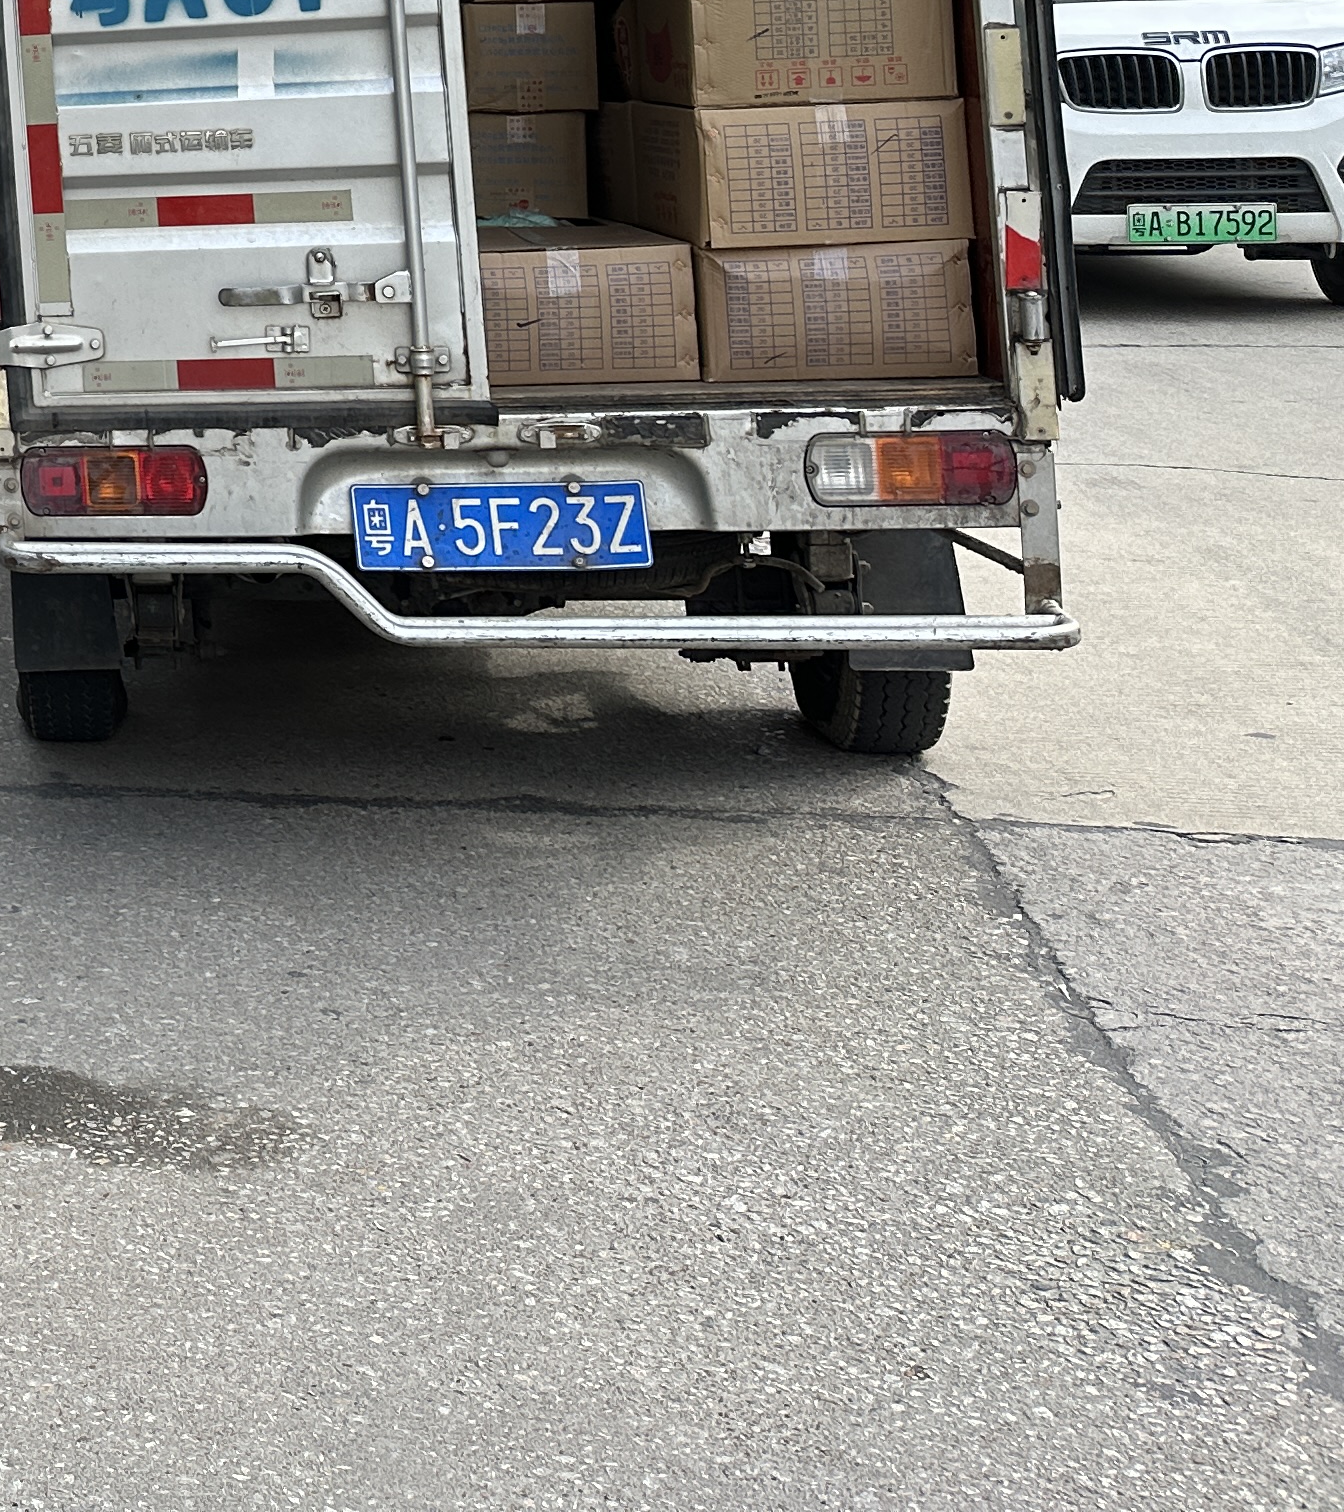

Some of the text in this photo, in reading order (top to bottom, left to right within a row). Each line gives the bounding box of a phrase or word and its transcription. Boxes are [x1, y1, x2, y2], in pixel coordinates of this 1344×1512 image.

[1141, 29, 1231, 46] SRM
[68, 127, 255, 157] 五菱 厢式运输车
